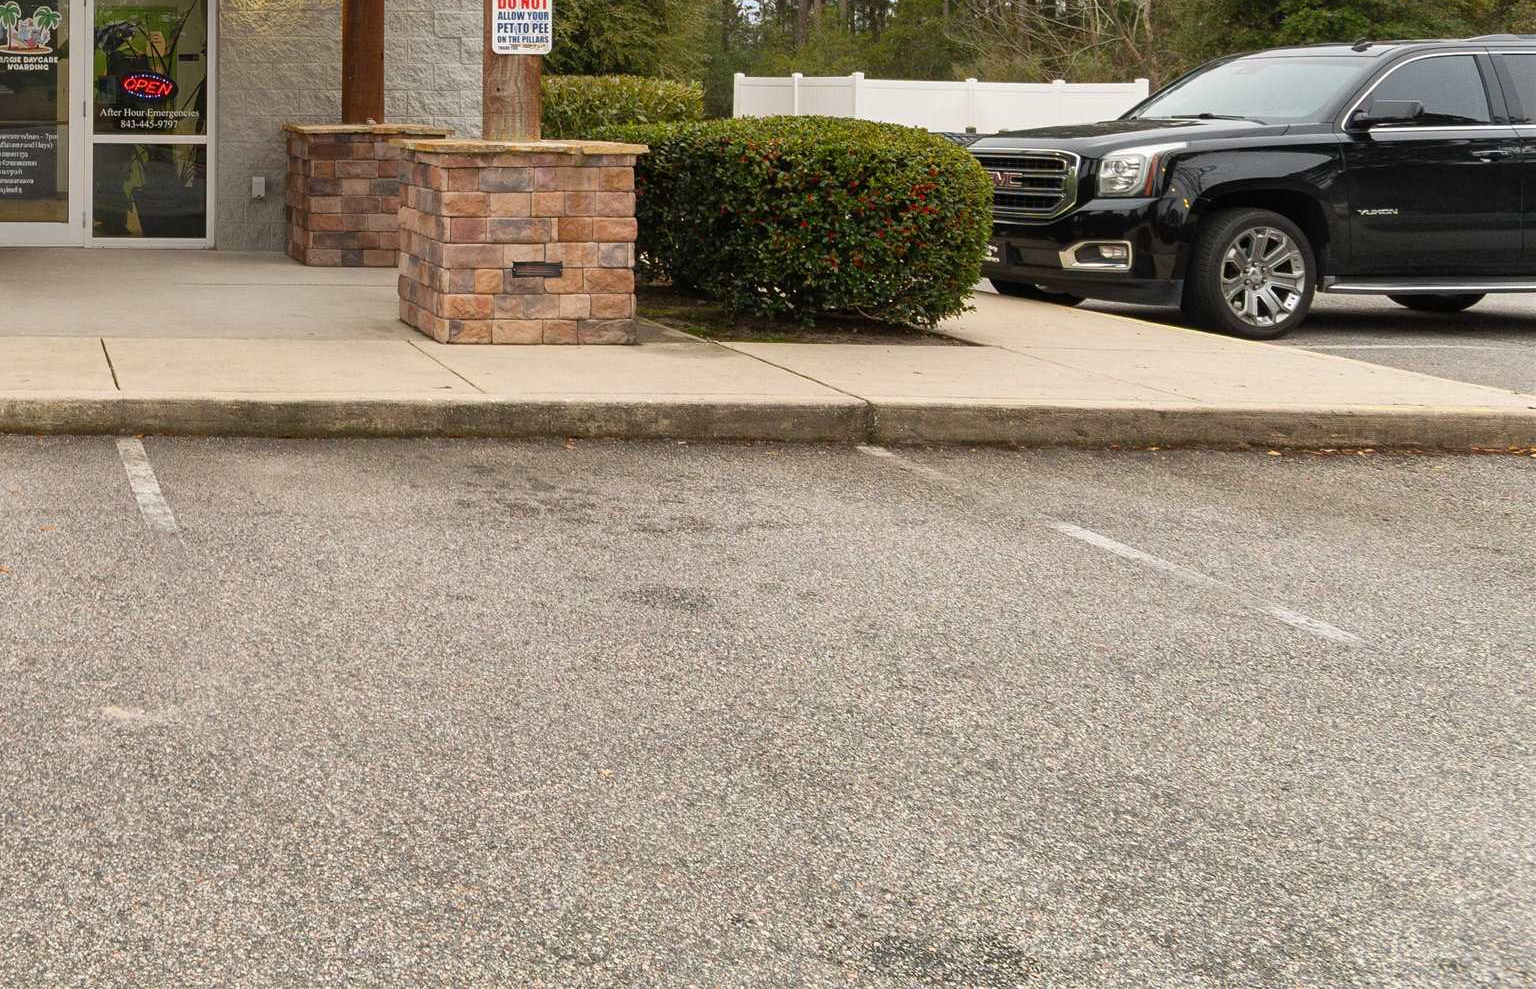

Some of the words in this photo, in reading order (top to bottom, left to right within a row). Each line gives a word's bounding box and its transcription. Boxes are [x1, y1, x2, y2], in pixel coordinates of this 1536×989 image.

[497, 11, 526, 21] ALLOW
[527, 11, 550, 21] YOUR
[497, 22, 515, 34] PET
[517, 22, 530, 34] TO
[532, 22, 550, 34] PEE
[497, 35, 507, 44] ON
[508, 35, 521, 44] THE
[522, 35, 550, 44] PILLARS
[124, 78, 173, 96] OPEN
[99, 108, 123, 117] After
[124, 108, 146, 117] Hour
[147, 108, 200, 119] Emergencies
[120, 119, 178, 129] 843-445-9797
[987, 171, 1024, 187] MC
